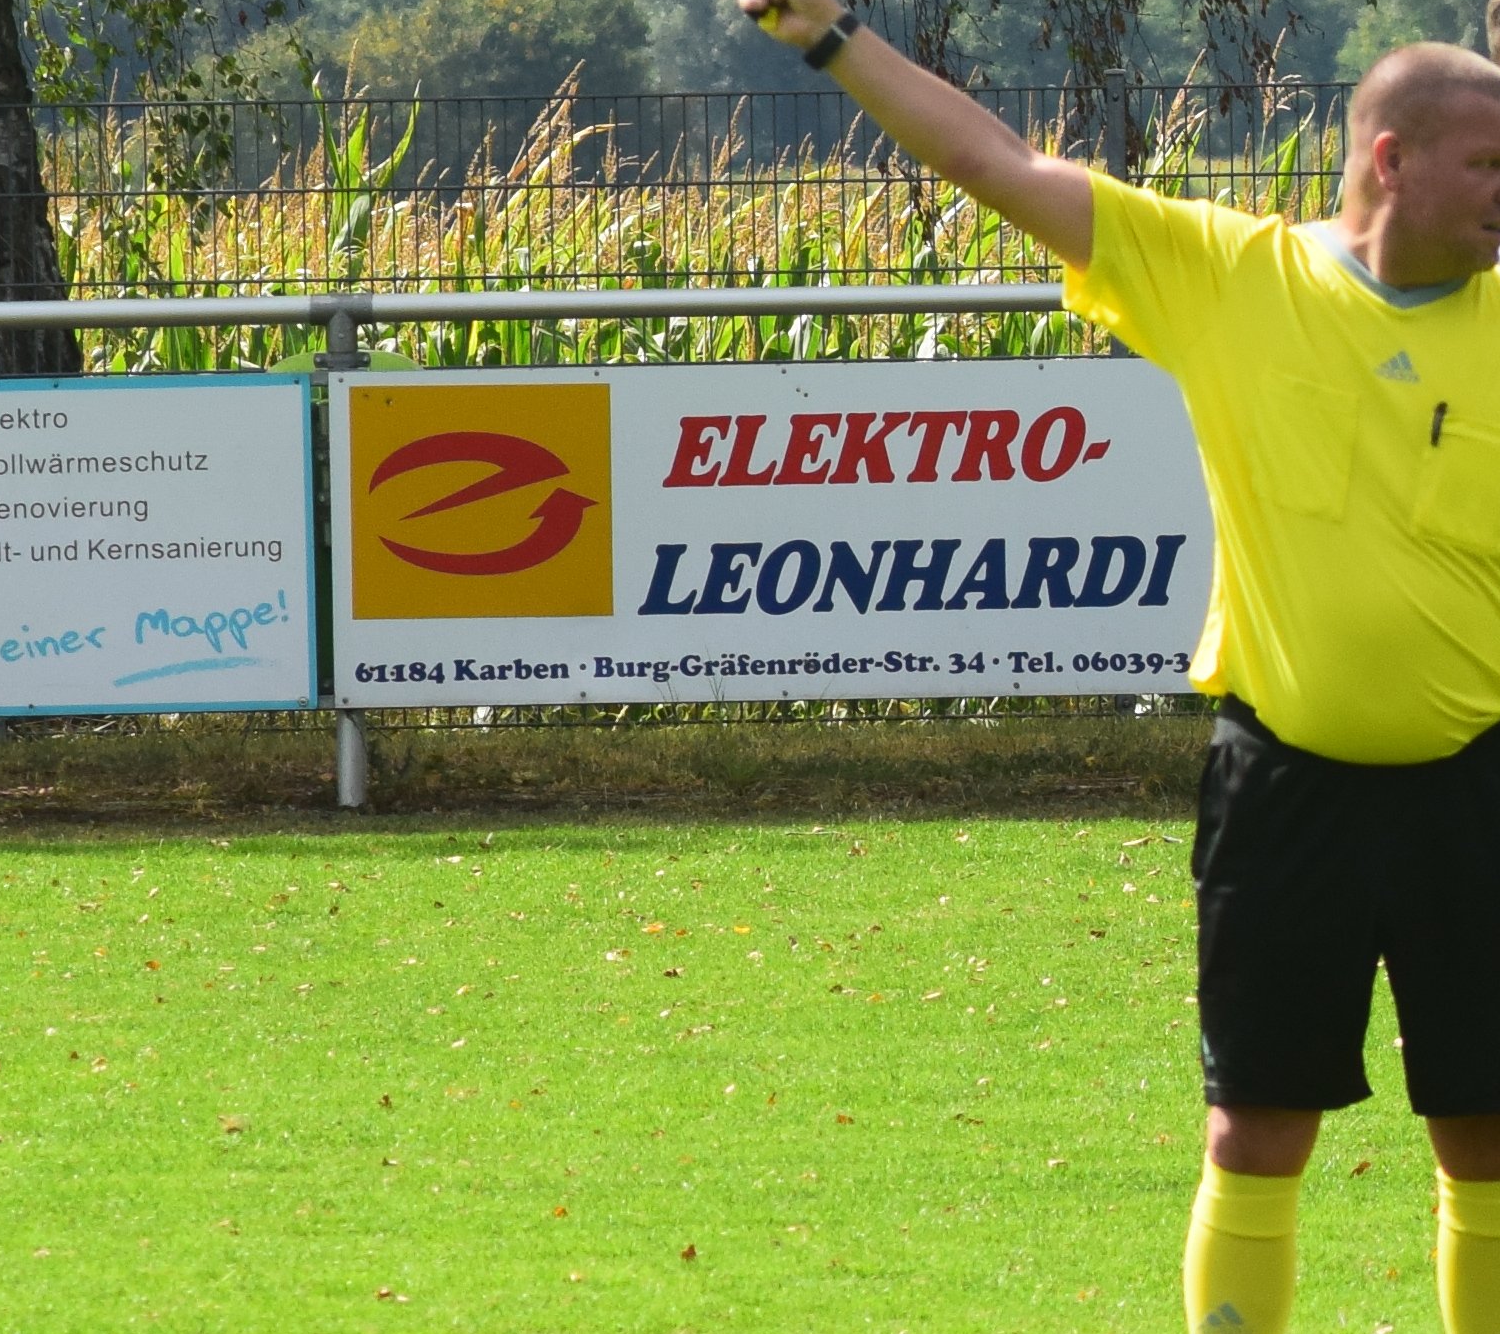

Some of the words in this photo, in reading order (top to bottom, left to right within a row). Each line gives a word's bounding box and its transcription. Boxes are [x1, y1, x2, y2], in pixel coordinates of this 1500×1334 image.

[662, 406, 1112, 488] ELEKTRO-
[30, 539, 78, 562] und
[87, 537, 283, 563] Kernsanierung
[638, 534, 1187, 618] LEONHARDI
[0, 623, 107, 662] einer
[134, 589, 291, 653] Mappe!
[355, 661, 445, 684] 61184
[453, 658, 570, 682] Karben
[593, 651, 941, 683] Burg-Gräfenröder-Str.
[948, 652, 986, 675] 34
[1007, 651, 1064, 674] Tel.
[1072, 651, 1191, 675] 06039-3
